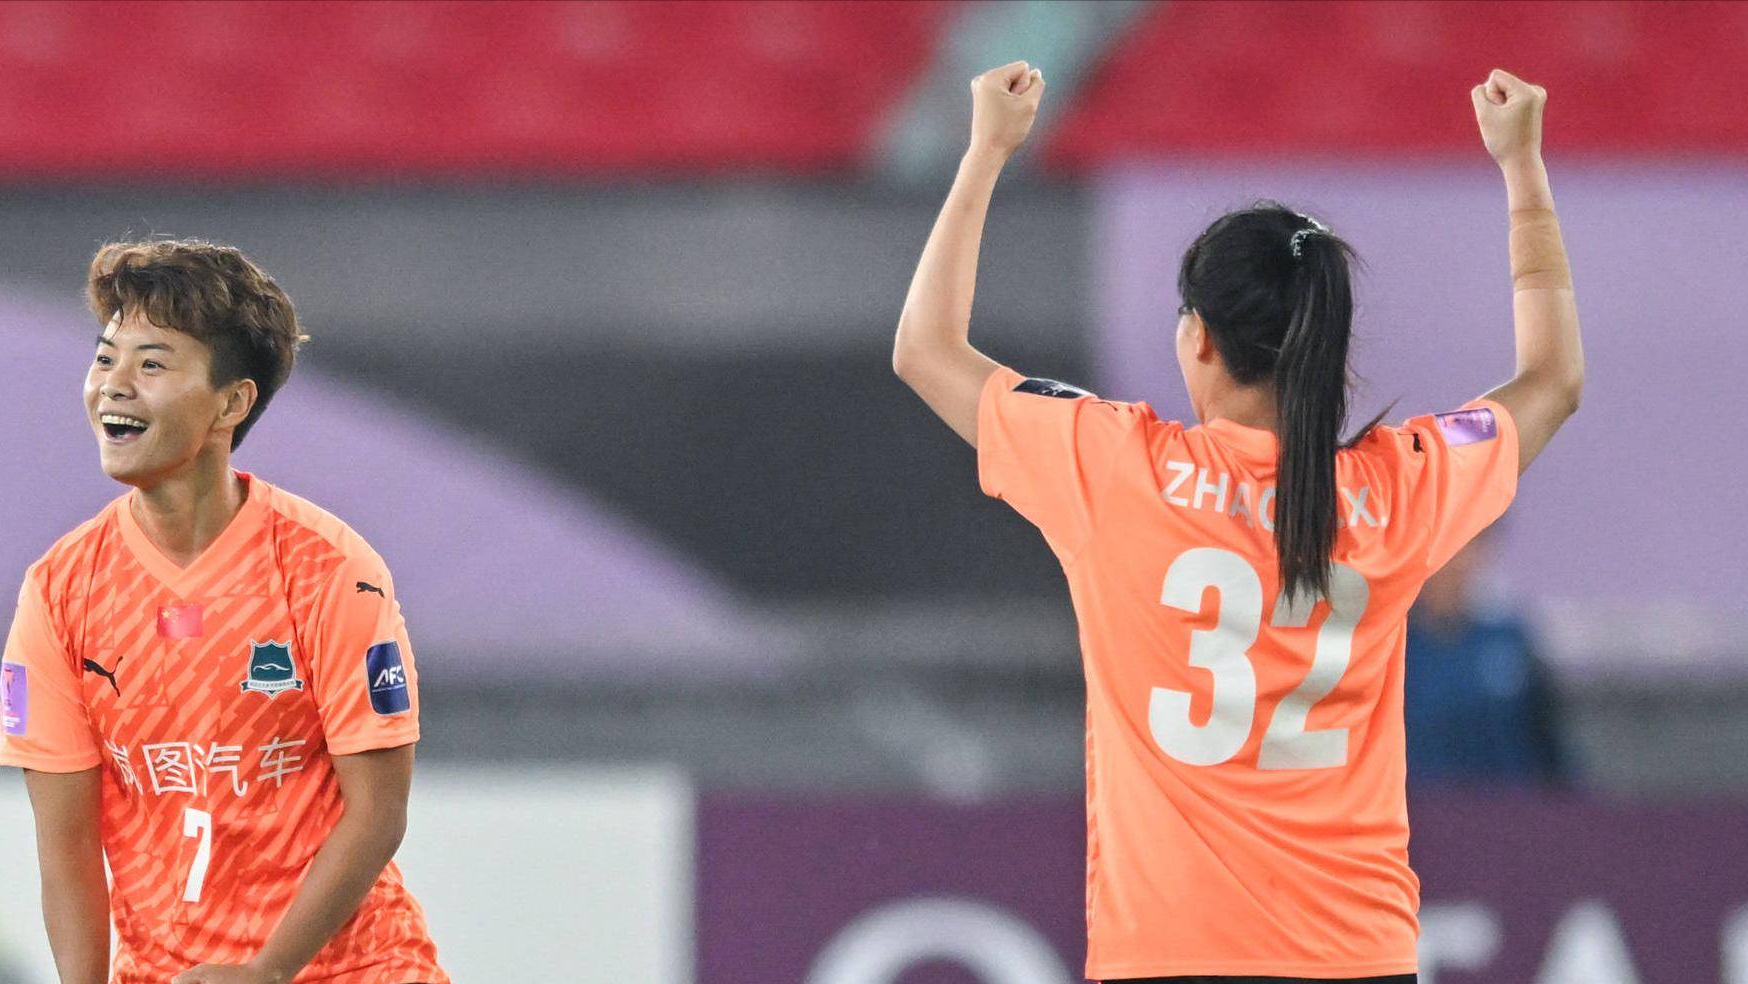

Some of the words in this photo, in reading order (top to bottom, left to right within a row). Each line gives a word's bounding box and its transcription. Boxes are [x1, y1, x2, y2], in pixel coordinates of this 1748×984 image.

[373, 664, 405, 688] AFC
[1148, 547, 1370, 770] 32
[183, 808, 211, 902] 7
